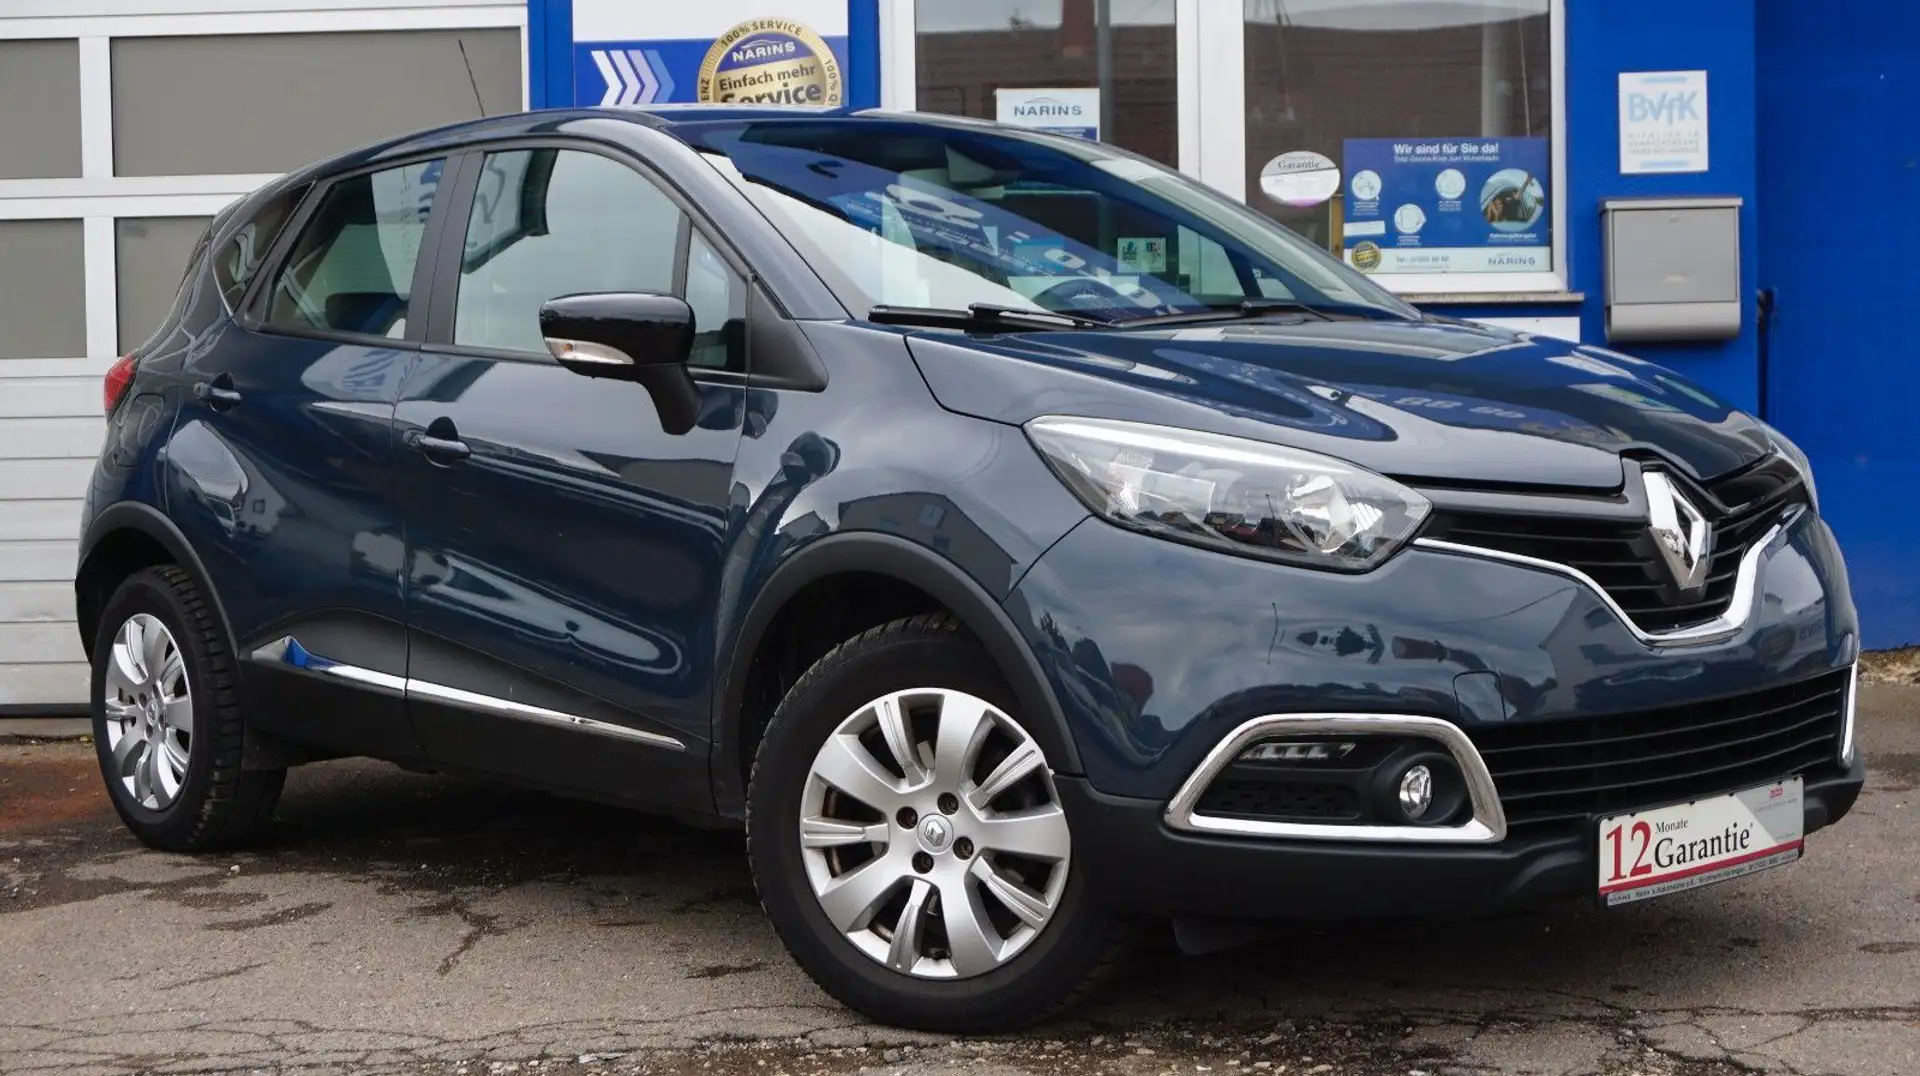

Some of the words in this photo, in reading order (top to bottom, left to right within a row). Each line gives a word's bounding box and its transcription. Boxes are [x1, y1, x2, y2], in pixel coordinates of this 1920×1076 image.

[721, 24, 750, 47] 100%
[752, 20, 802, 36] SERVICE
[732, 41, 796, 62] NARINS
[719, 70, 774, 92] Einfach
[777, 64, 816, 81] mehr
[824, 59, 839, 91] 100%
[1013, 105, 1083, 117] NARINS
[1394, 143, 1412, 154] Wir
[1416, 143, 1440, 154] sind
[1442, 143, 1458, 154] für
[1461, 142, 1479, 153] Sie
[1481, 142, 1499, 153] da!
[1278, 159, 1321, 169] Garantie
[1487, 256, 1536, 266] NARINS
[1606, 821, 1652, 882] 12
[1655, 819, 1689, 833] Monate
